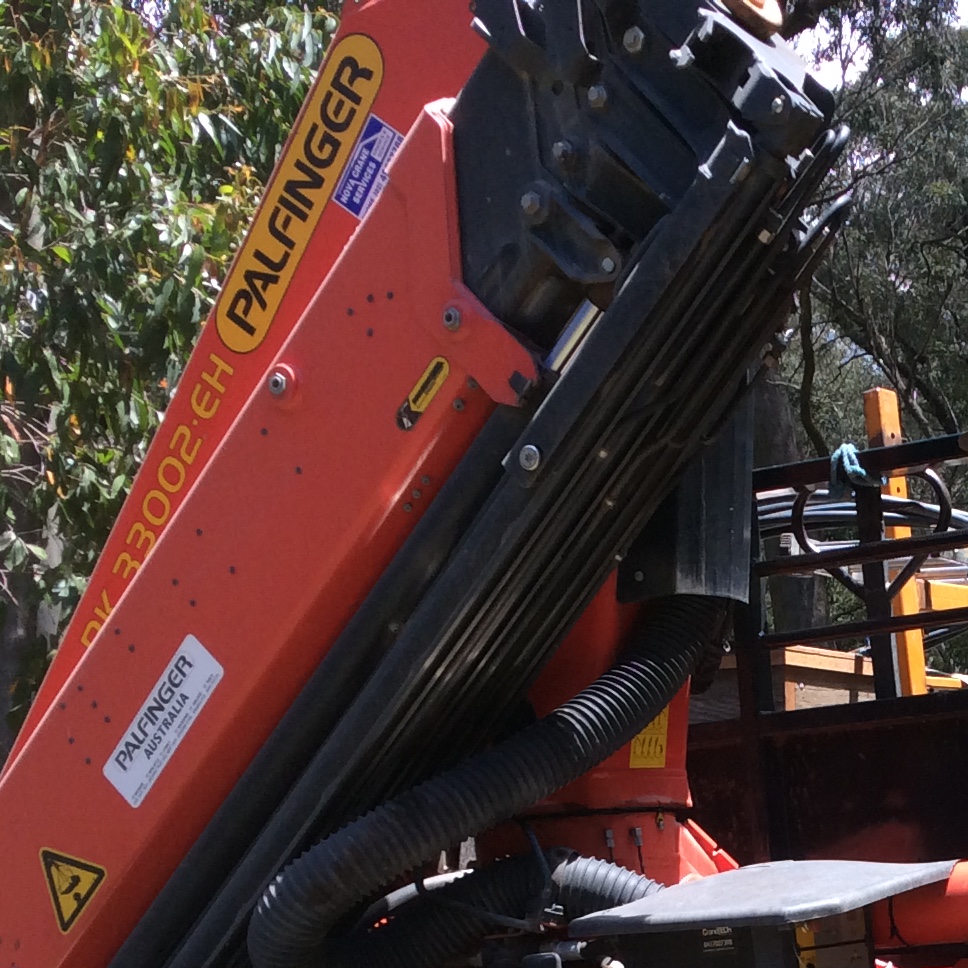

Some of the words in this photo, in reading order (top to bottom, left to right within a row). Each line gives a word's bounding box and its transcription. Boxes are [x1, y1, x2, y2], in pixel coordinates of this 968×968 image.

[225, 54, 374, 337] PALFINGER
[340, 177, 358, 204] NOVA
[351, 147, 371, 178] CRANE
[352, 161, 377, 205] SERVICES
[114, 653, 194, 772] PALFINGER
[143, 692, 190, 760] AUSTRALIA
